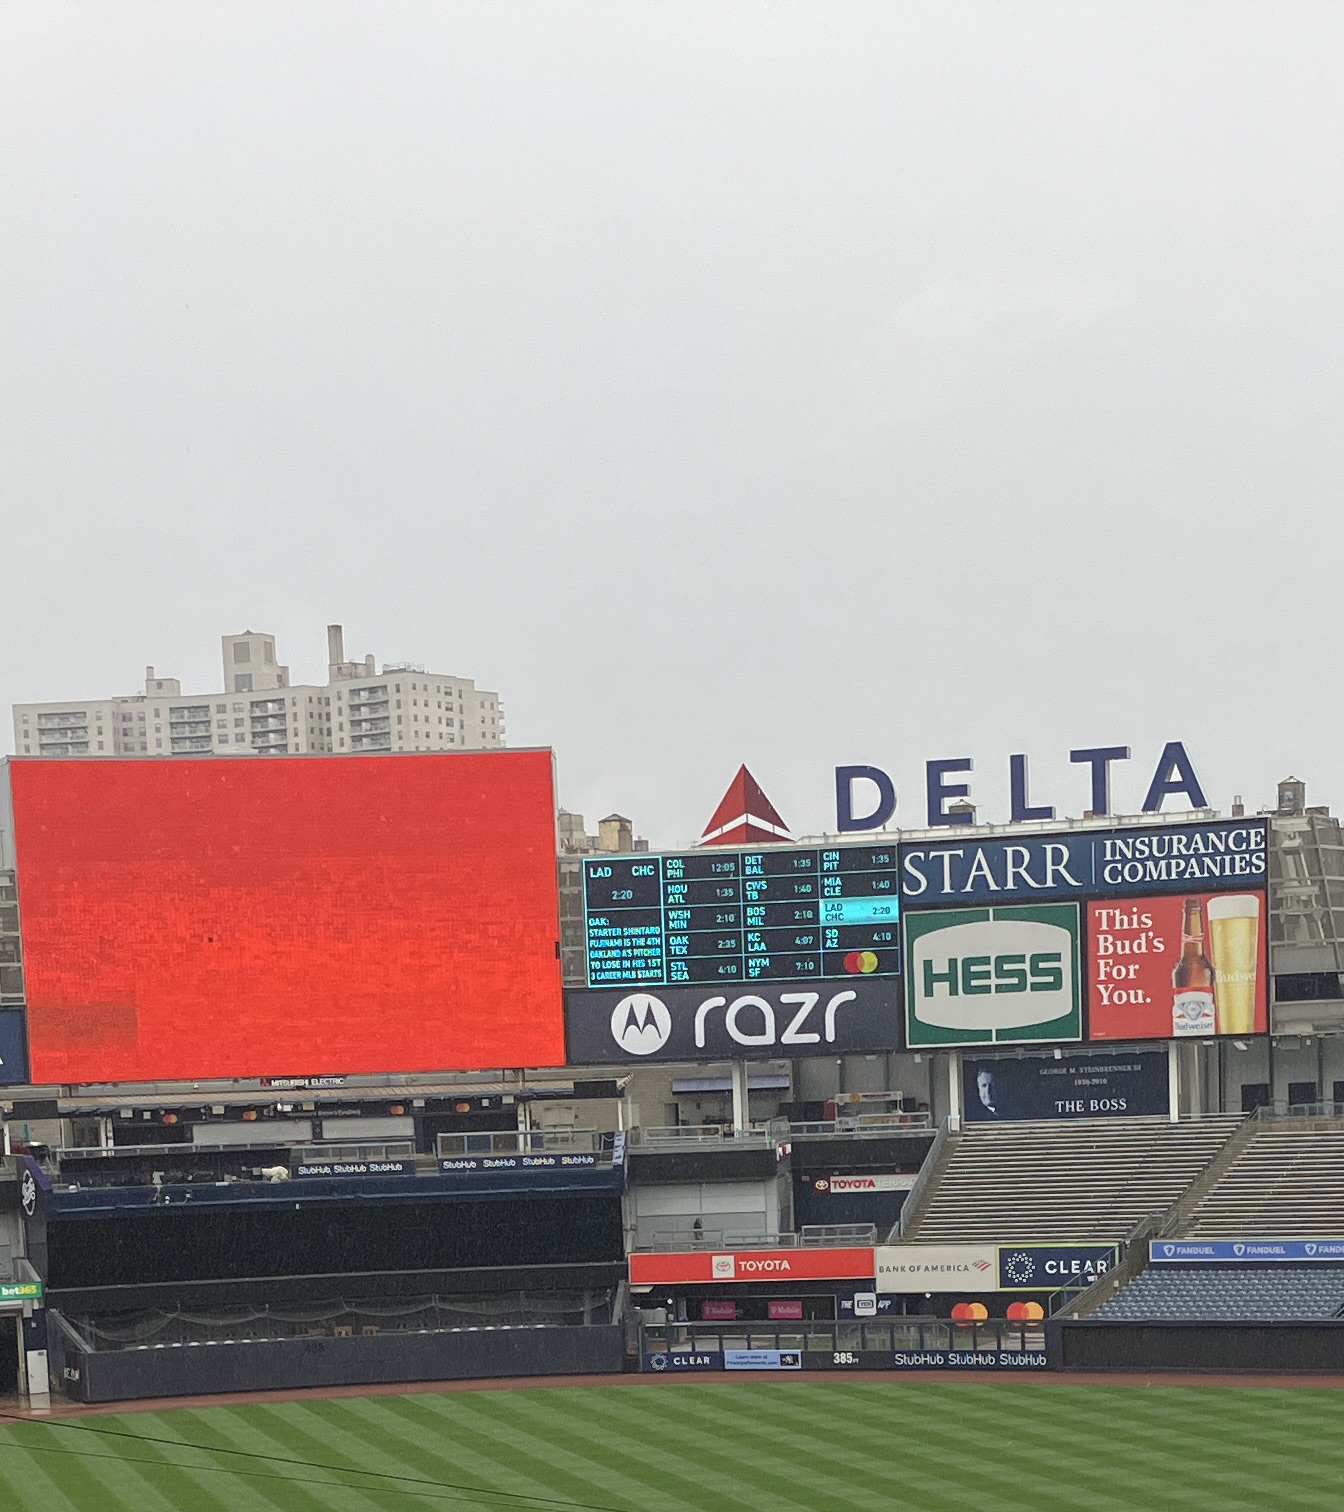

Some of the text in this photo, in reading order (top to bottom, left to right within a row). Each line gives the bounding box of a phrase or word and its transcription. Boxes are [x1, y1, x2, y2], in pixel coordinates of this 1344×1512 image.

[835, 741, 1207, 832] DELTA
[745, 856, 763, 865] DET
[823, 852, 839, 861] CIN
[666, 859, 685, 869] COL
[824, 861, 839, 871] PIT
[903, 828, 1265, 896] STARR INSURANCE
[590, 865, 655, 878] LAD CHC
[746, 866, 764, 875] BAL
[1103, 852, 1265, 884] COMPANIES
[667, 869, 683, 878] PHI
[824, 877, 842, 886] MIA
[668, 884, 688, 894] HOU
[824, 887, 841, 896] CLE
[612, 890, 633, 900] 2:20
[668, 895, 685, 903] ATL
[746, 891, 758, 900] TB
[747, 907, 765, 916] BOS
[825, 903, 843, 912] LAD
[668, 910, 691, 920] WSH
[825, 913, 844, 922] CHC
[1095, 907, 1153, 930] This
[589, 917, 609, 926] OAK:
[669, 920, 687, 929] MIN
[747, 917, 764, 926] MIL
[748, 933, 761, 942] KC
[826, 929, 838, 938] SD
[669, 936, 689, 945] OAK
[826, 939, 838, 948] AZ
[1097, 932, 1165, 955] Bud's
[670, 946, 687, 955] TEX
[748, 942, 766, 951] LAA
[670, 961, 688, 971] STL
[749, 958, 769, 968] NYM
[749, 968, 760, 977] SF
[923, 951, 1063, 997] HESS
[1097, 959, 1139, 980] For
[671, 971, 689, 981] SEA
[1096, 983, 1152, 1005] You.
[695, 990, 856, 1049] razr
[271, 1077, 344, 1086] MITSUBISHI ELECTRIC
[1055, 1098, 1127, 1113] THE BOSS
[298, 1156, 594, 1174] StubHub StubHub StubHub StubHub StubHub StubHub StubHub
[832, 1179, 876, 1189] TOYOTA
[1177, 1246, 1215, 1255] FANDUEL
[1247, 1246, 1286, 1255] FANDUEL
[738, 1260, 791, 1271] TOYOTA
[879, 1264, 969, 1273] BANK OF AMERICA
[1045, 1260, 1107, 1275] CLEAR
[2, 1285, 36, 1296] bet365
[673, 1357, 710, 1365] CLEAR
[833, 1353, 853, 1364] 385
[895, 1354, 1047, 1366] StubHub StubHub StubHub
